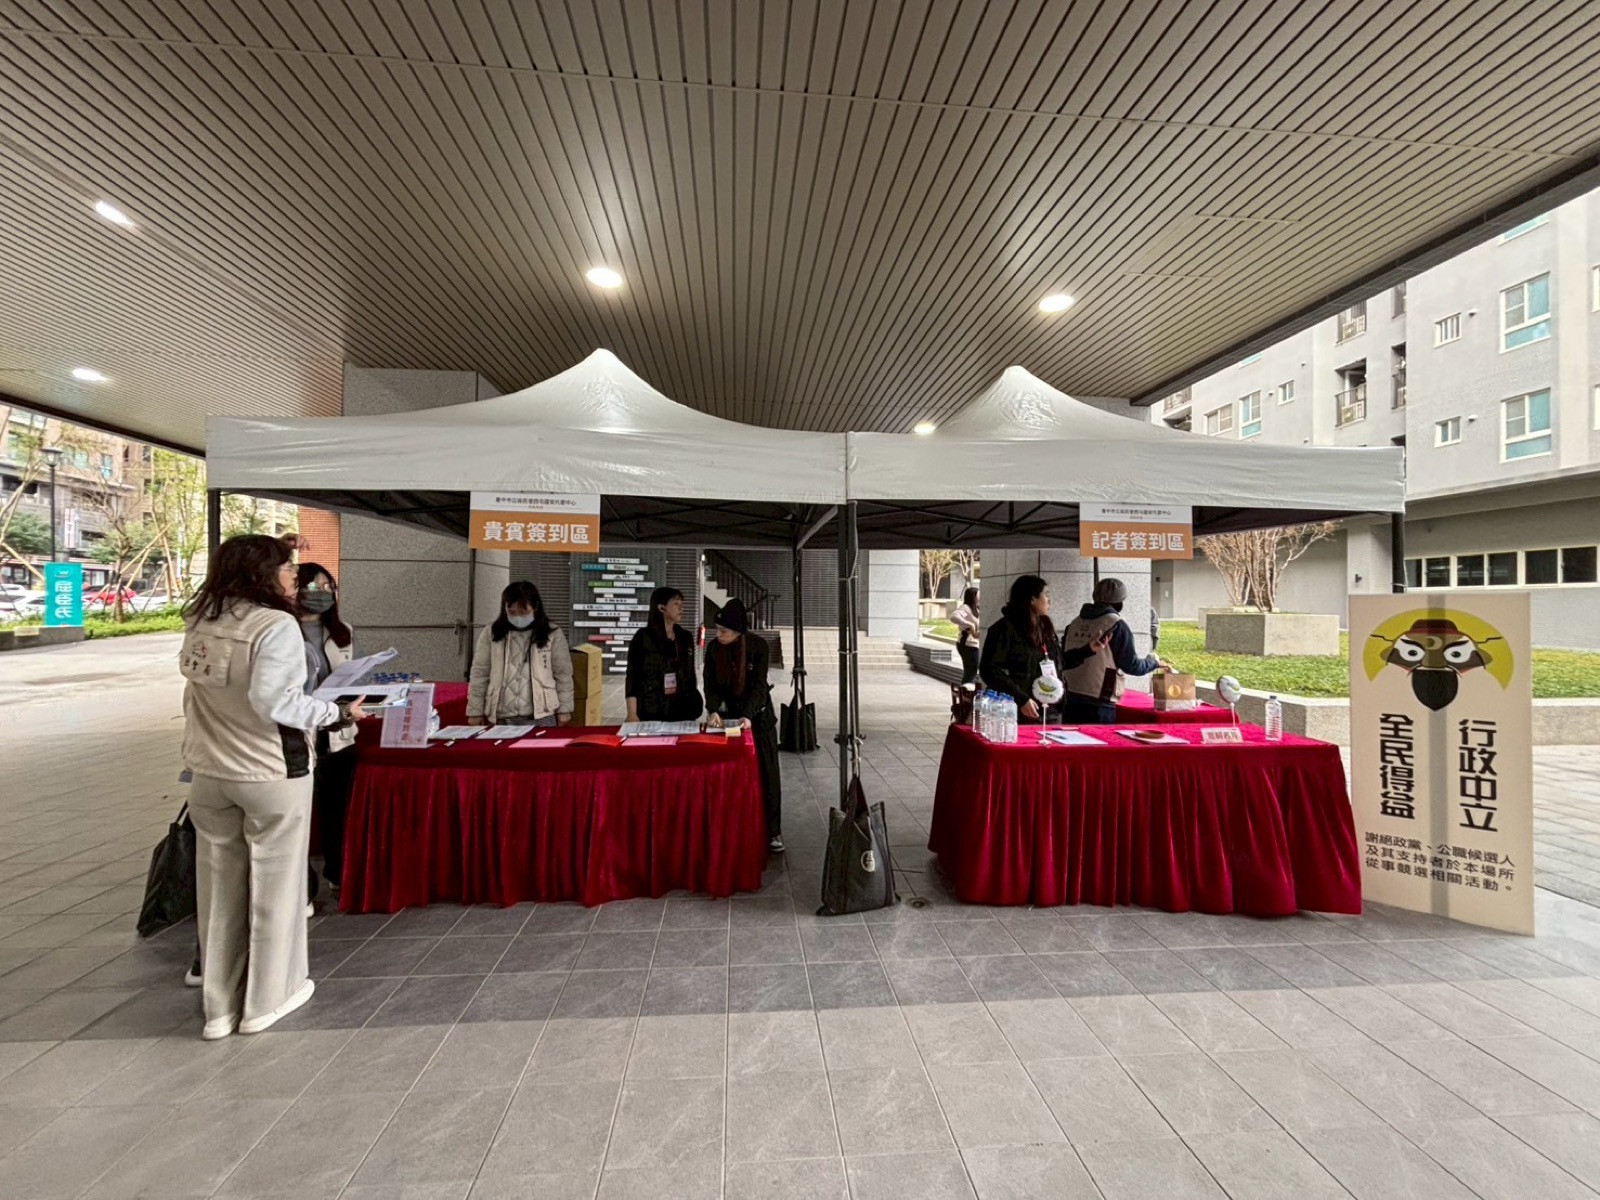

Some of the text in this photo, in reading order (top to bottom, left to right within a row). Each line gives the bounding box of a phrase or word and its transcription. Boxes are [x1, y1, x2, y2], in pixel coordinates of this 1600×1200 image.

[482, 520, 590, 545] 貴賓簽到區
[1091, 530, 1185, 551] 記者簽到區
[1379, 713, 1416, 820] 全民得益
[1458, 718, 1499, 832] 行政中立
[1364, 831, 1516, 868] 謝絕政黨、公職候選人
[1364, 844, 1515, 882] 及其支持者於本場所
[1364, 857, 1513, 892] 從事競選相關活動。
